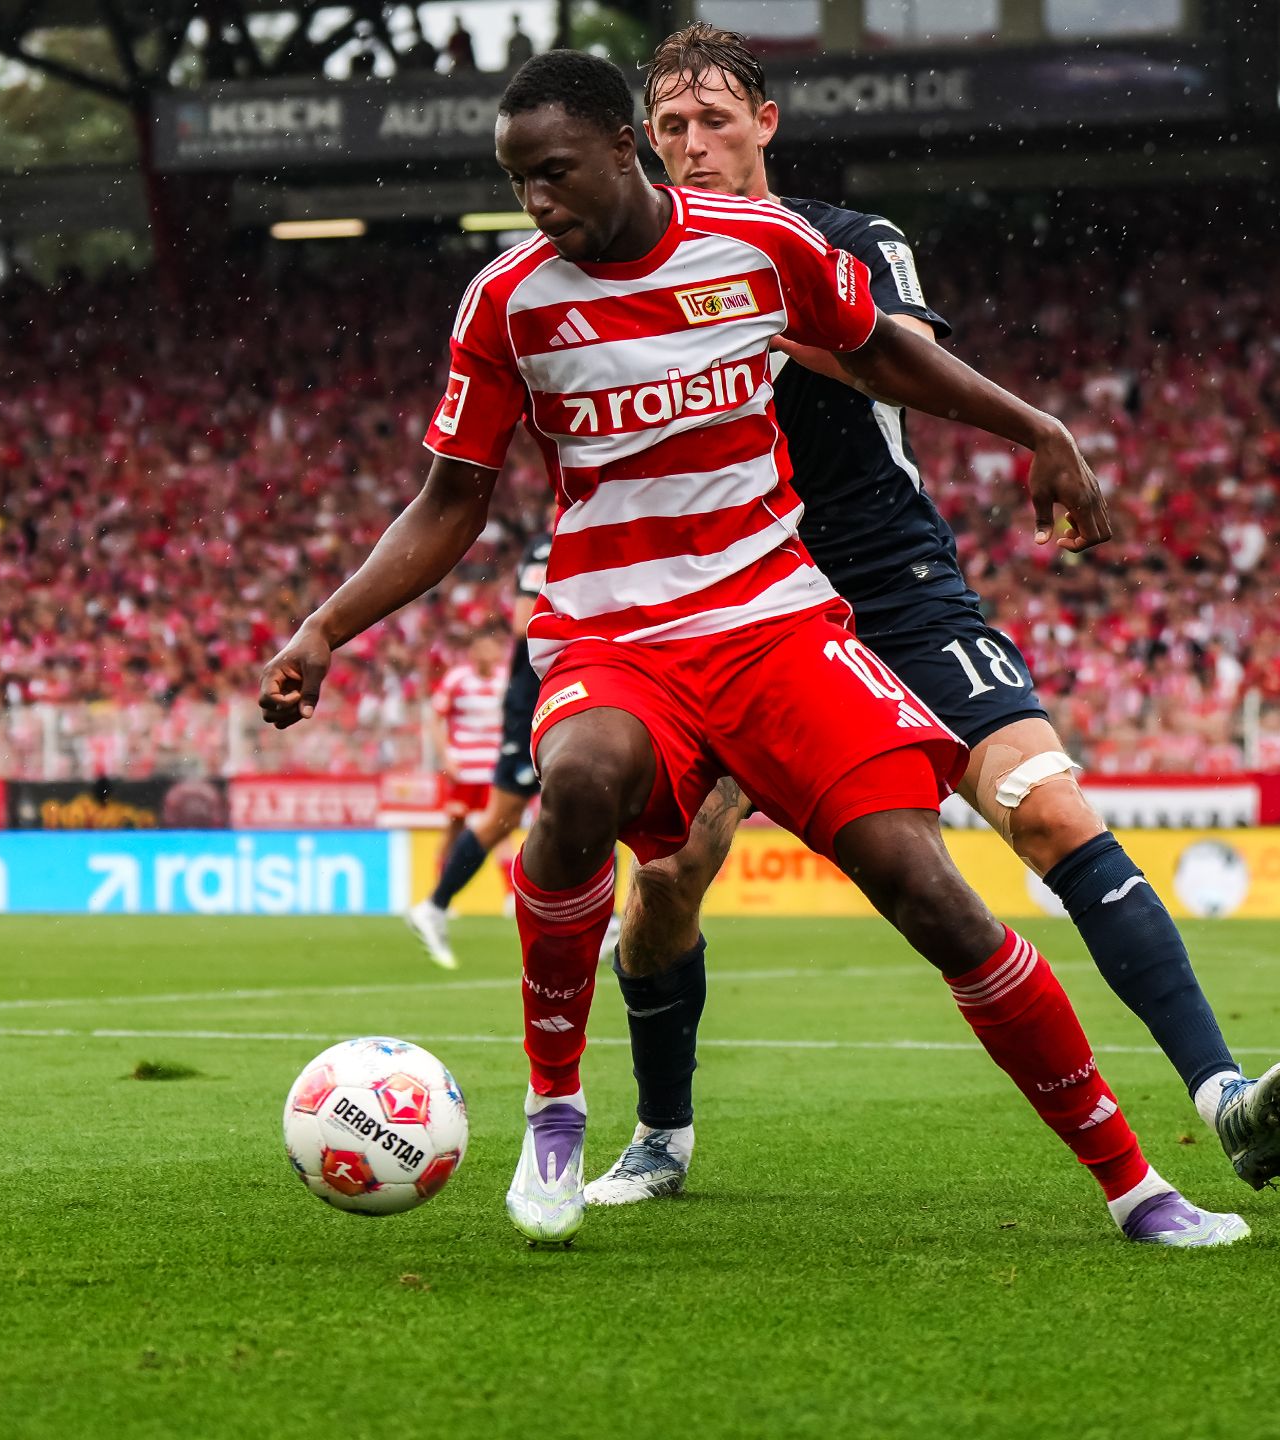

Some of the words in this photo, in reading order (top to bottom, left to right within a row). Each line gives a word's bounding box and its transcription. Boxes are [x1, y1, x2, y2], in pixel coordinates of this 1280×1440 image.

[210, 98, 342, 134] KOCH
[379, 101, 503, 137] AUTO
[721, 293, 751, 311] UNION
[881, 241, 916, 304] ProMinent
[608, 357, 755, 430] raisin
[823, 638, 905, 700] 10
[941, 636, 1025, 699] 18
[154, 836, 365, 912] raisin
[333, 1097, 425, 1169] DERBYSTAR
